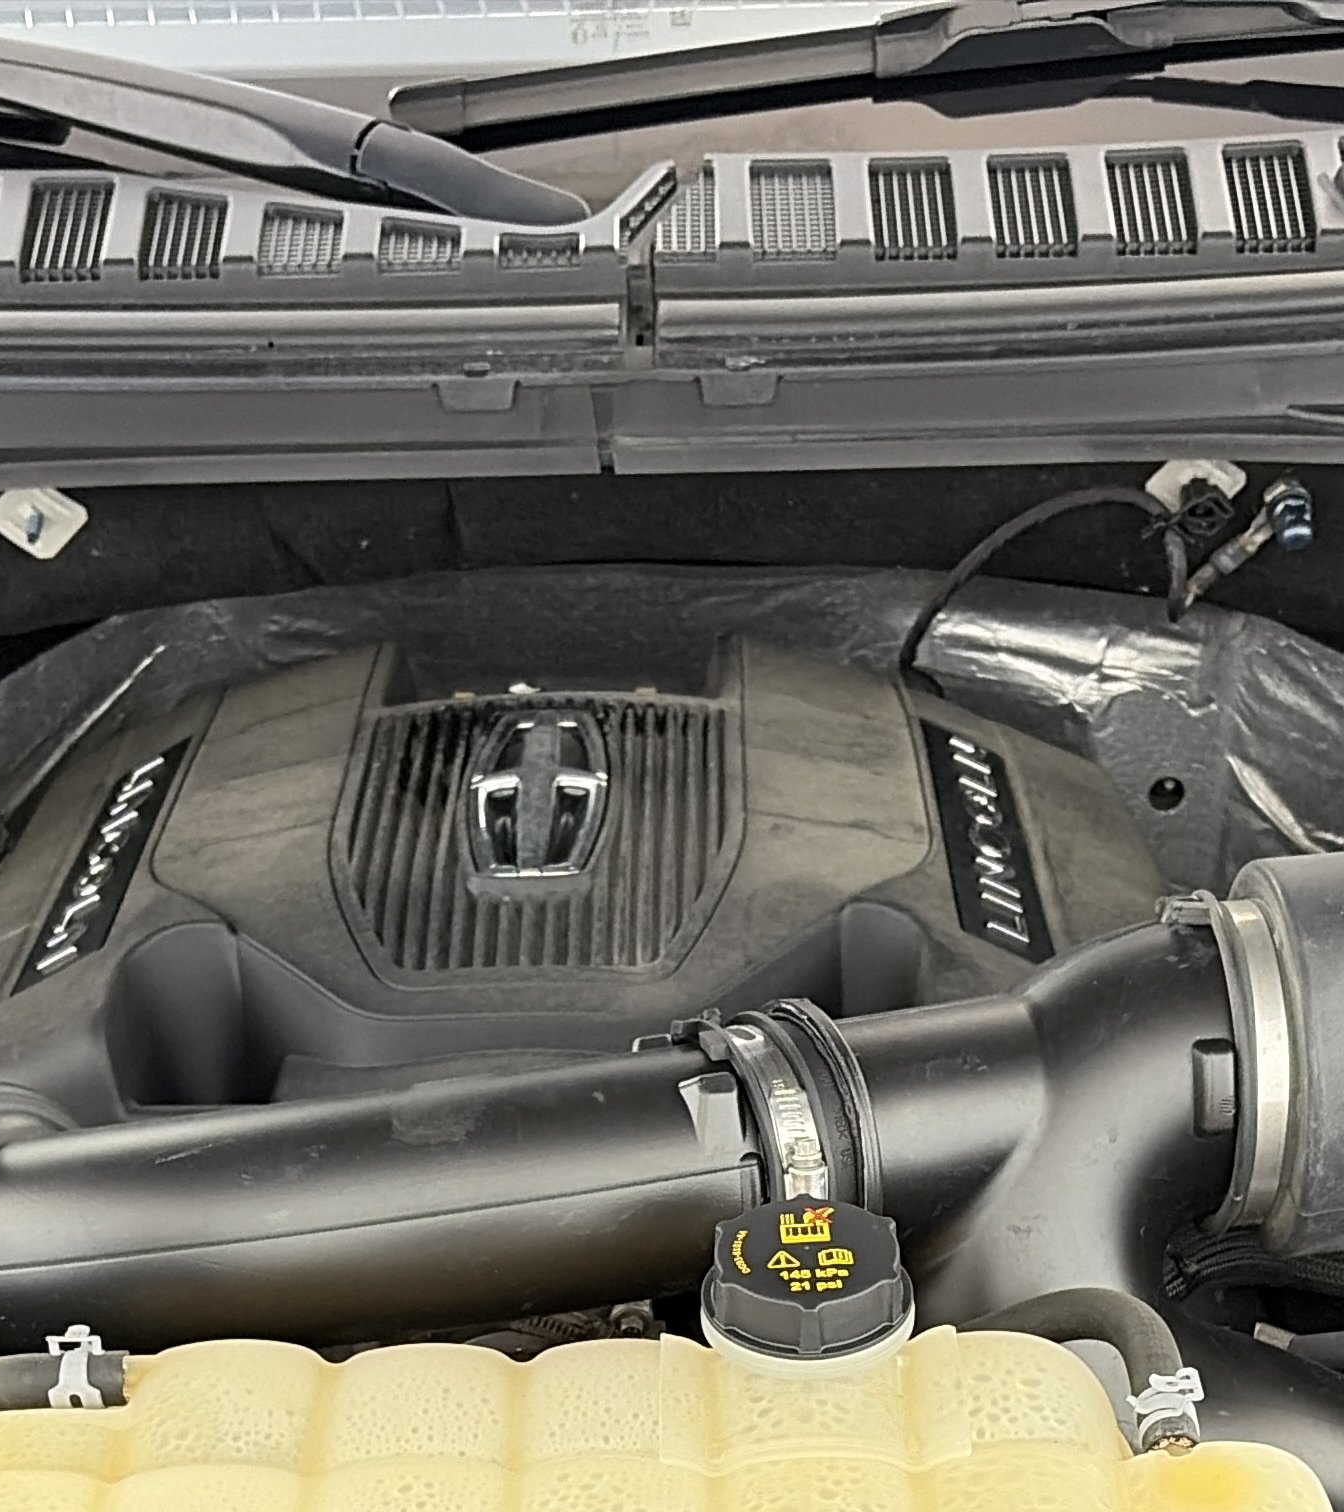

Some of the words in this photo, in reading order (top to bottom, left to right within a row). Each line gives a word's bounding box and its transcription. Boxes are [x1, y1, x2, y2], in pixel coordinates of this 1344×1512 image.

[36, 756, 165, 974] LINCOLN
[948, 735, 1031, 943] LINCOLN
[779, 1269, 812, 1280] 145
[815, 1268, 849, 1278] kPa
[789, 1280, 811, 1291] 21
[816, 1279, 843, 1291] psi
